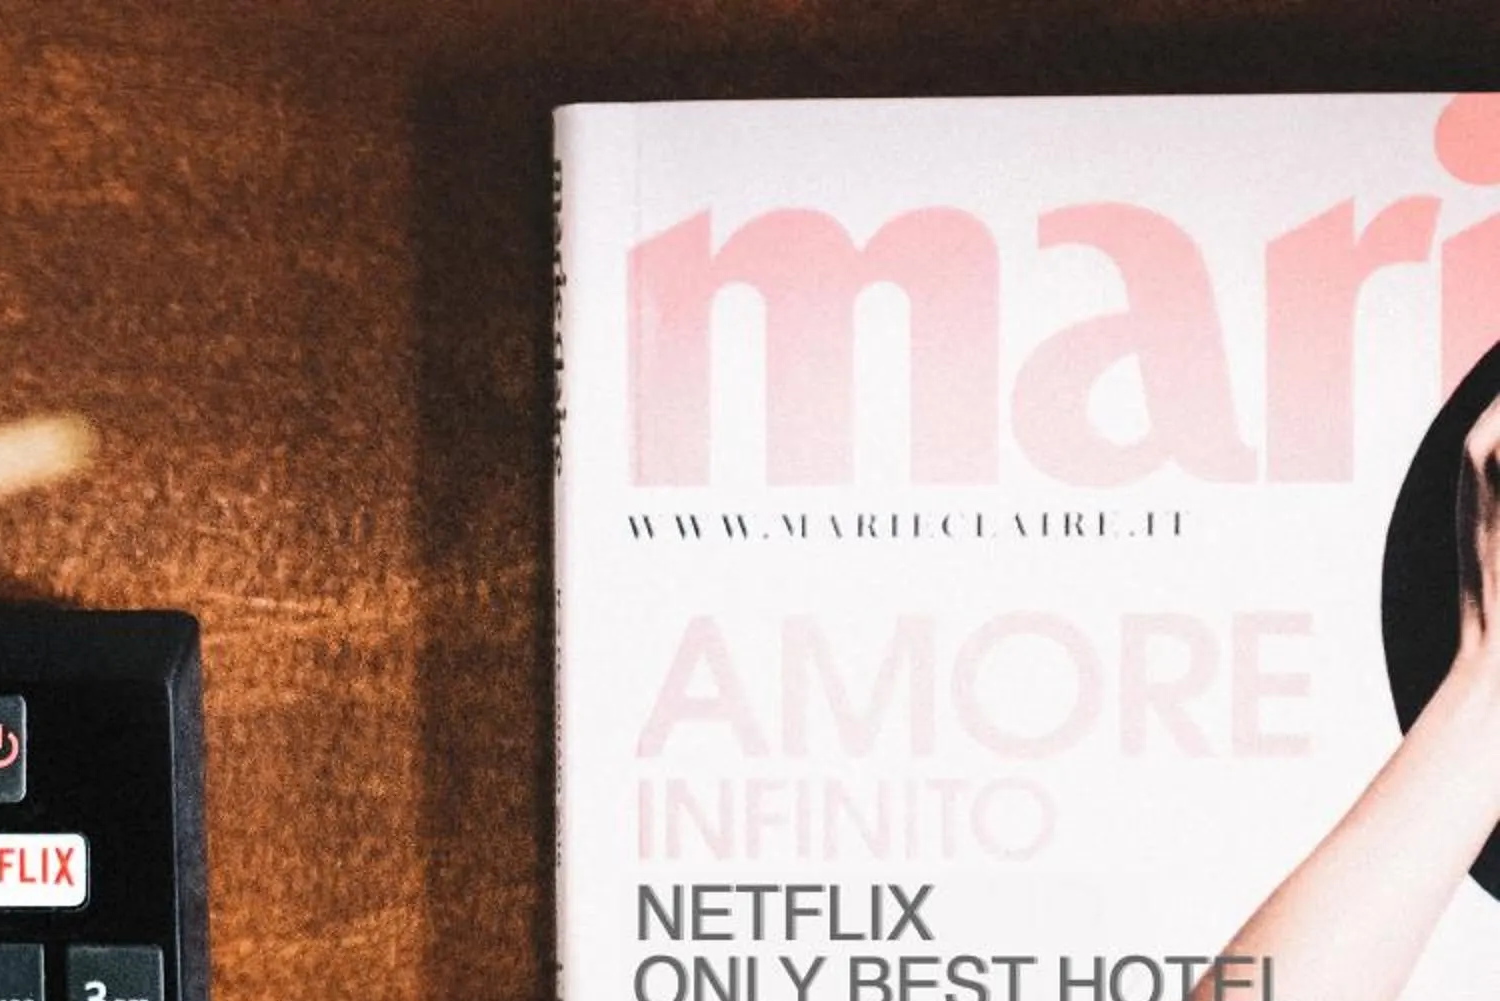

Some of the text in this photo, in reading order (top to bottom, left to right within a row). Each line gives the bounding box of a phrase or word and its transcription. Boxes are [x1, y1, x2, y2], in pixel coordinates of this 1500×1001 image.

[628, 511, 1188, 540] WWW.MARIECLAIRE.IT
[634, 609, 1316, 760] AMORE
[636, 777, 1058, 862] INFINITO
[637, 883, 935, 941] NETFLIX
